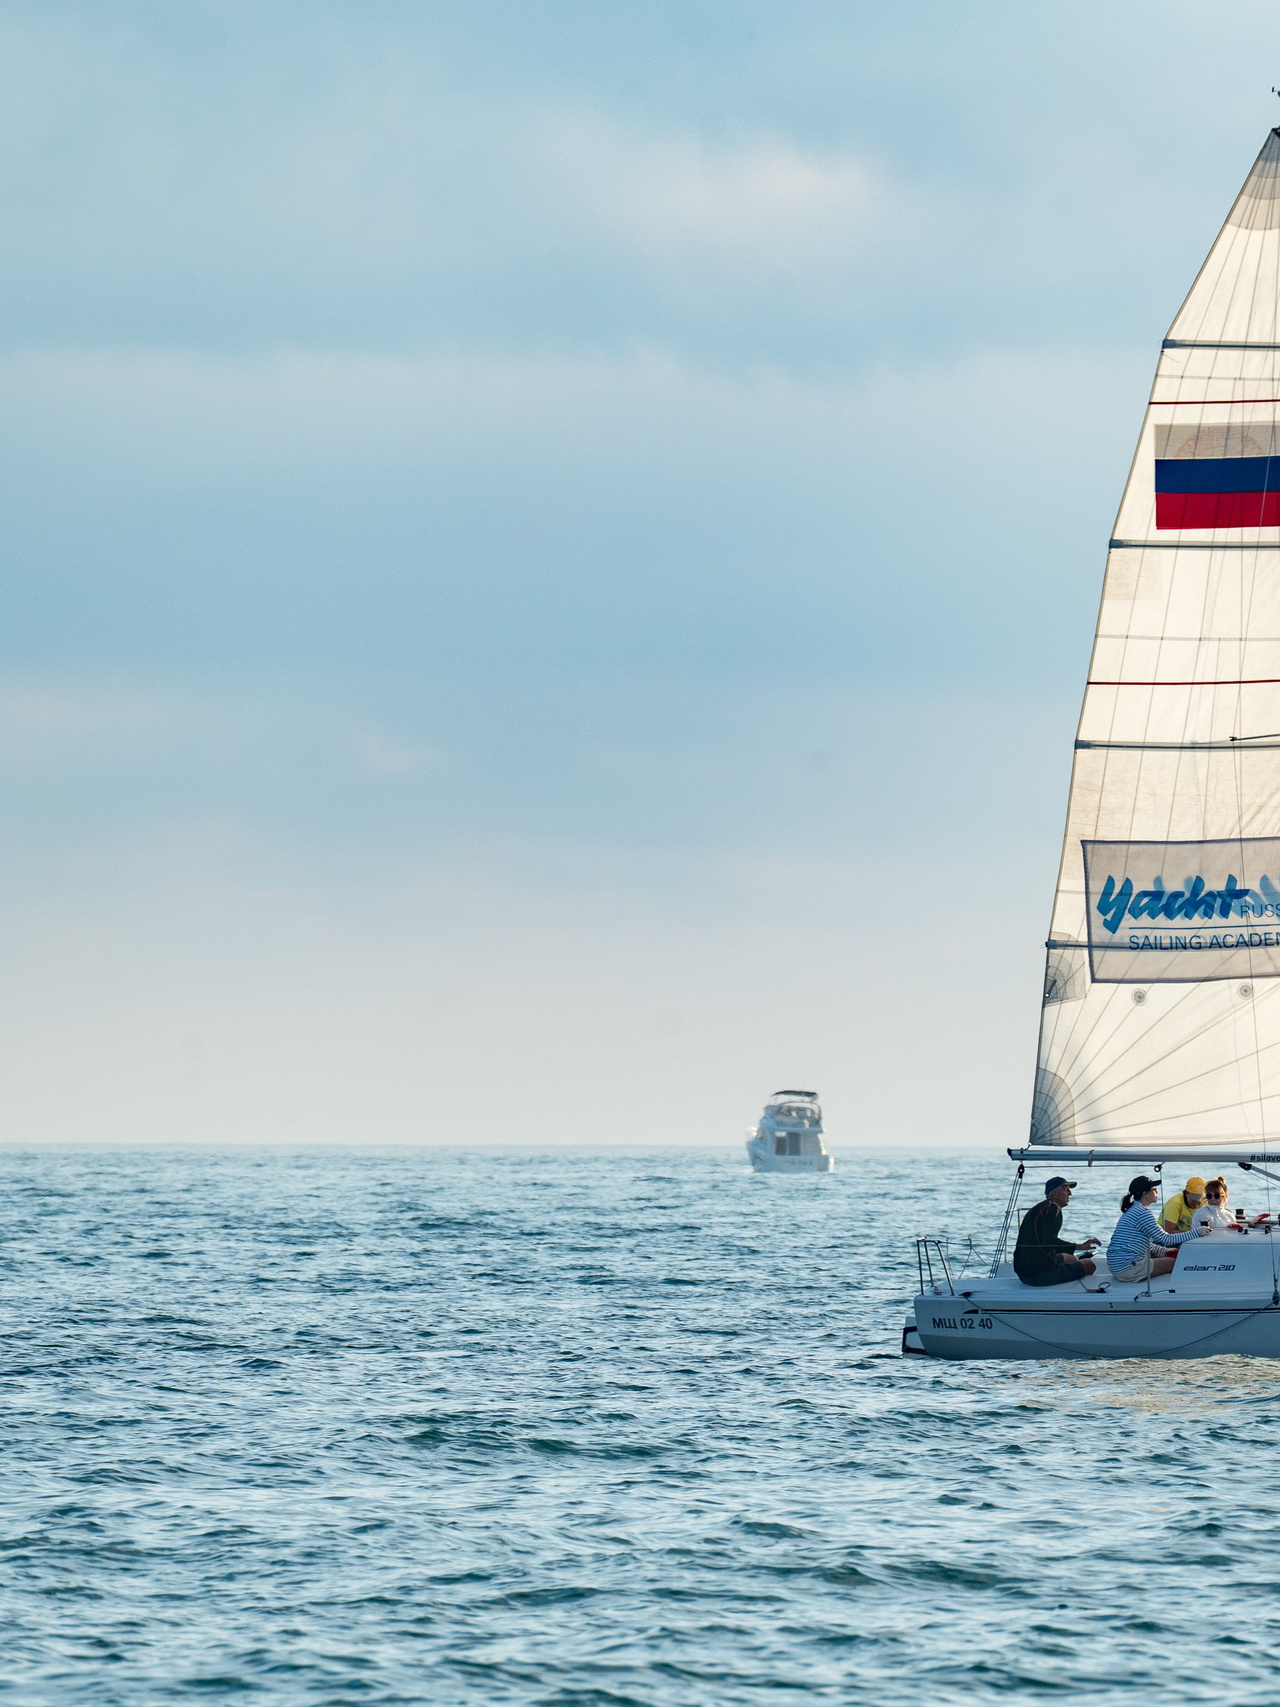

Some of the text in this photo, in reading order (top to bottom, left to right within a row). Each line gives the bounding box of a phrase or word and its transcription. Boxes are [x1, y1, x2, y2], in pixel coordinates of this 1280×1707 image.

[1128, 934, 1202, 951] SAILING
[960, 1317, 975, 1330] 02
[978, 1317, 993, 1330] 40
